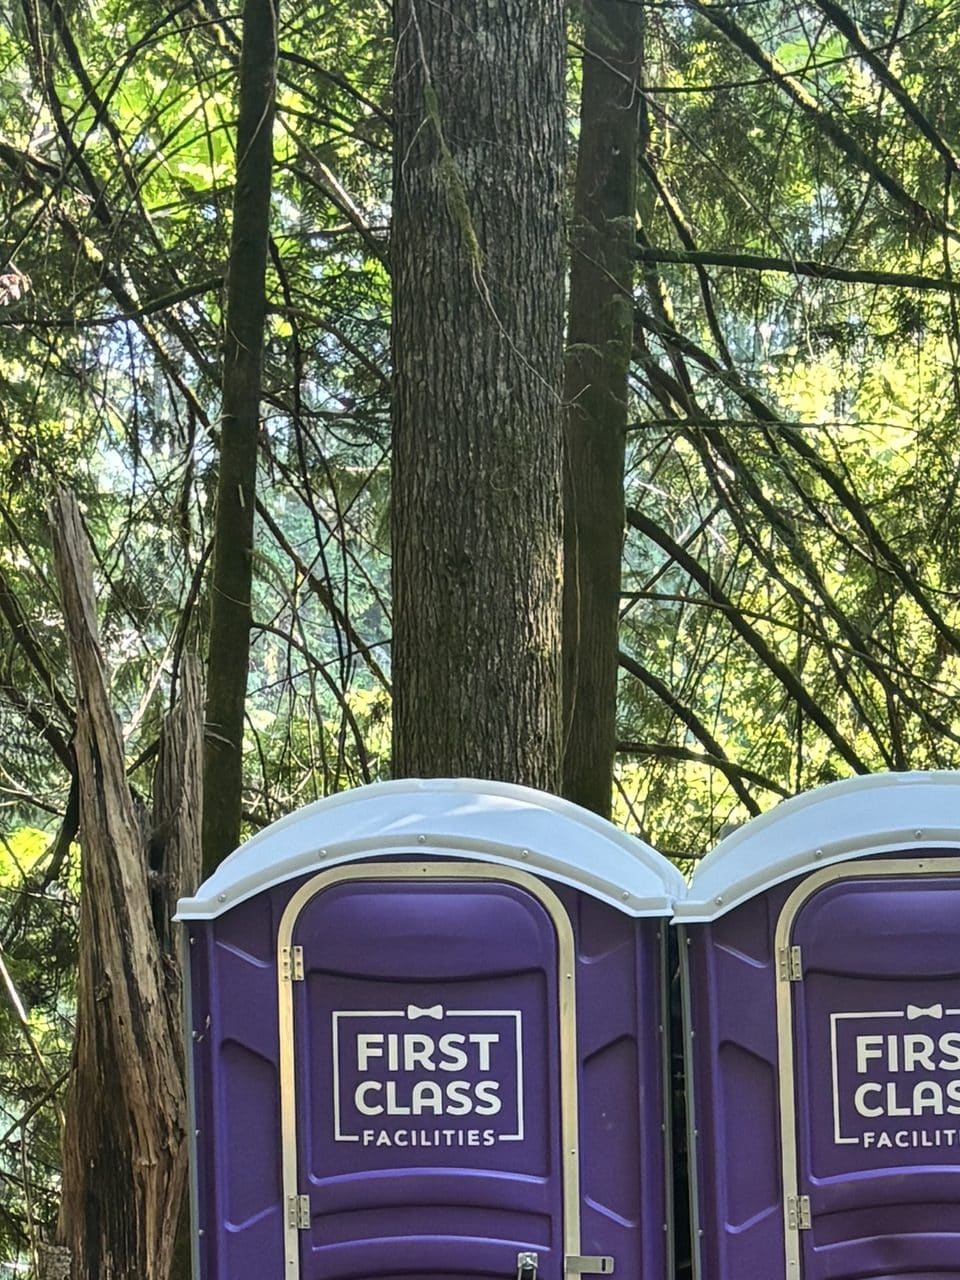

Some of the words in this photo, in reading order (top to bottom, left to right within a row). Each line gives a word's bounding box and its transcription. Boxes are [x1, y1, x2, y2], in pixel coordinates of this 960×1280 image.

[357, 1034, 499, 1071] FIRST
[355, 1081, 501, 1115] CLASS
[363, 1130, 495, 1146] FACILITIES
